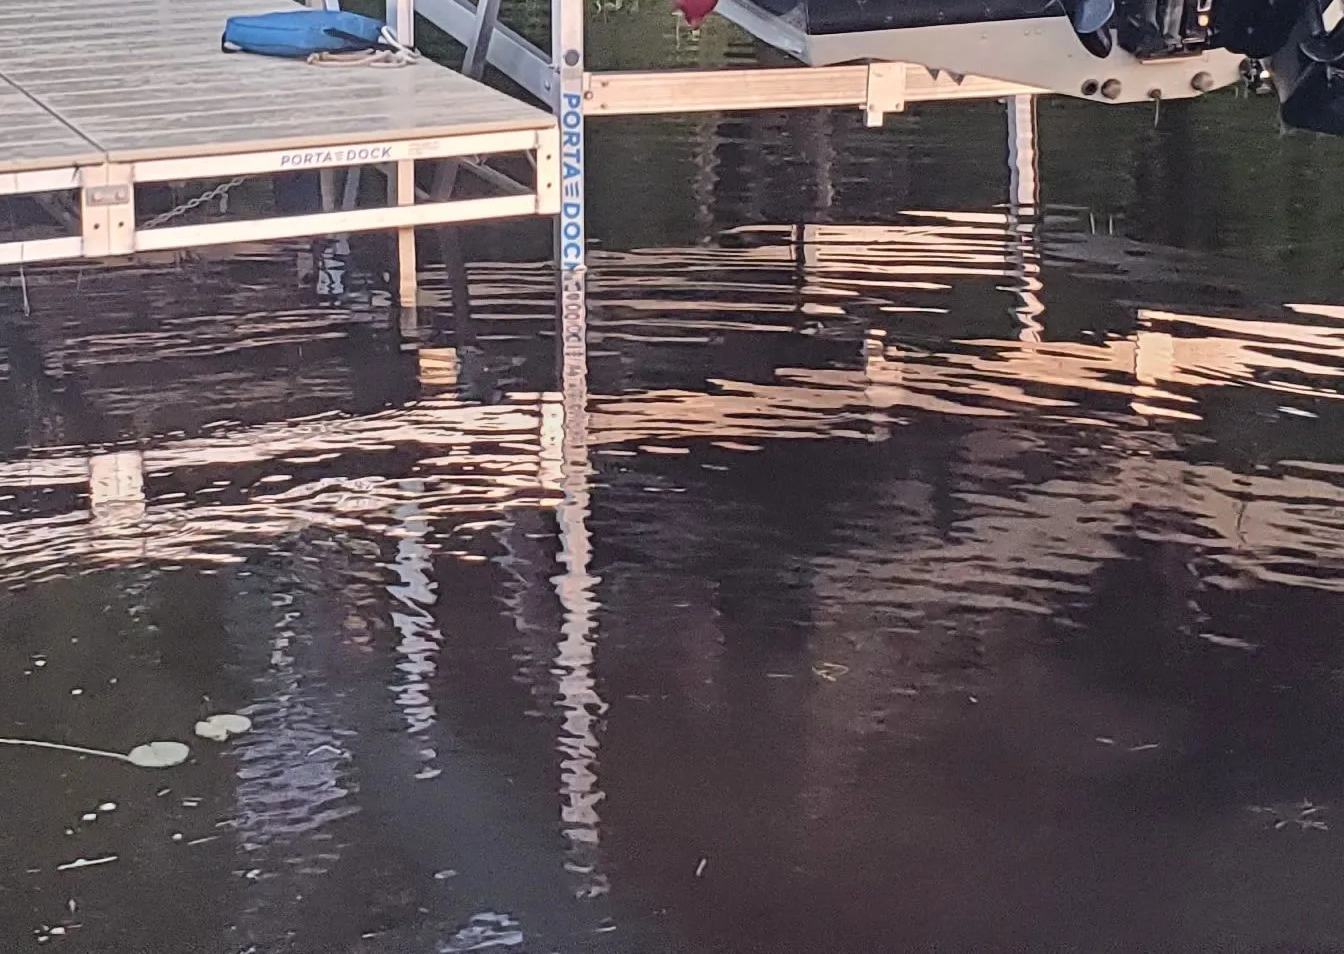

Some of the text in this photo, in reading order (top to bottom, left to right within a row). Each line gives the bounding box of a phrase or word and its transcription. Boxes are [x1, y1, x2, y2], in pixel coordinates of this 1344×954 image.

[280, 151, 332, 167] PORTA
[346, 146, 393, 160] DOCK
[563, 93, 581, 178] PORTA
